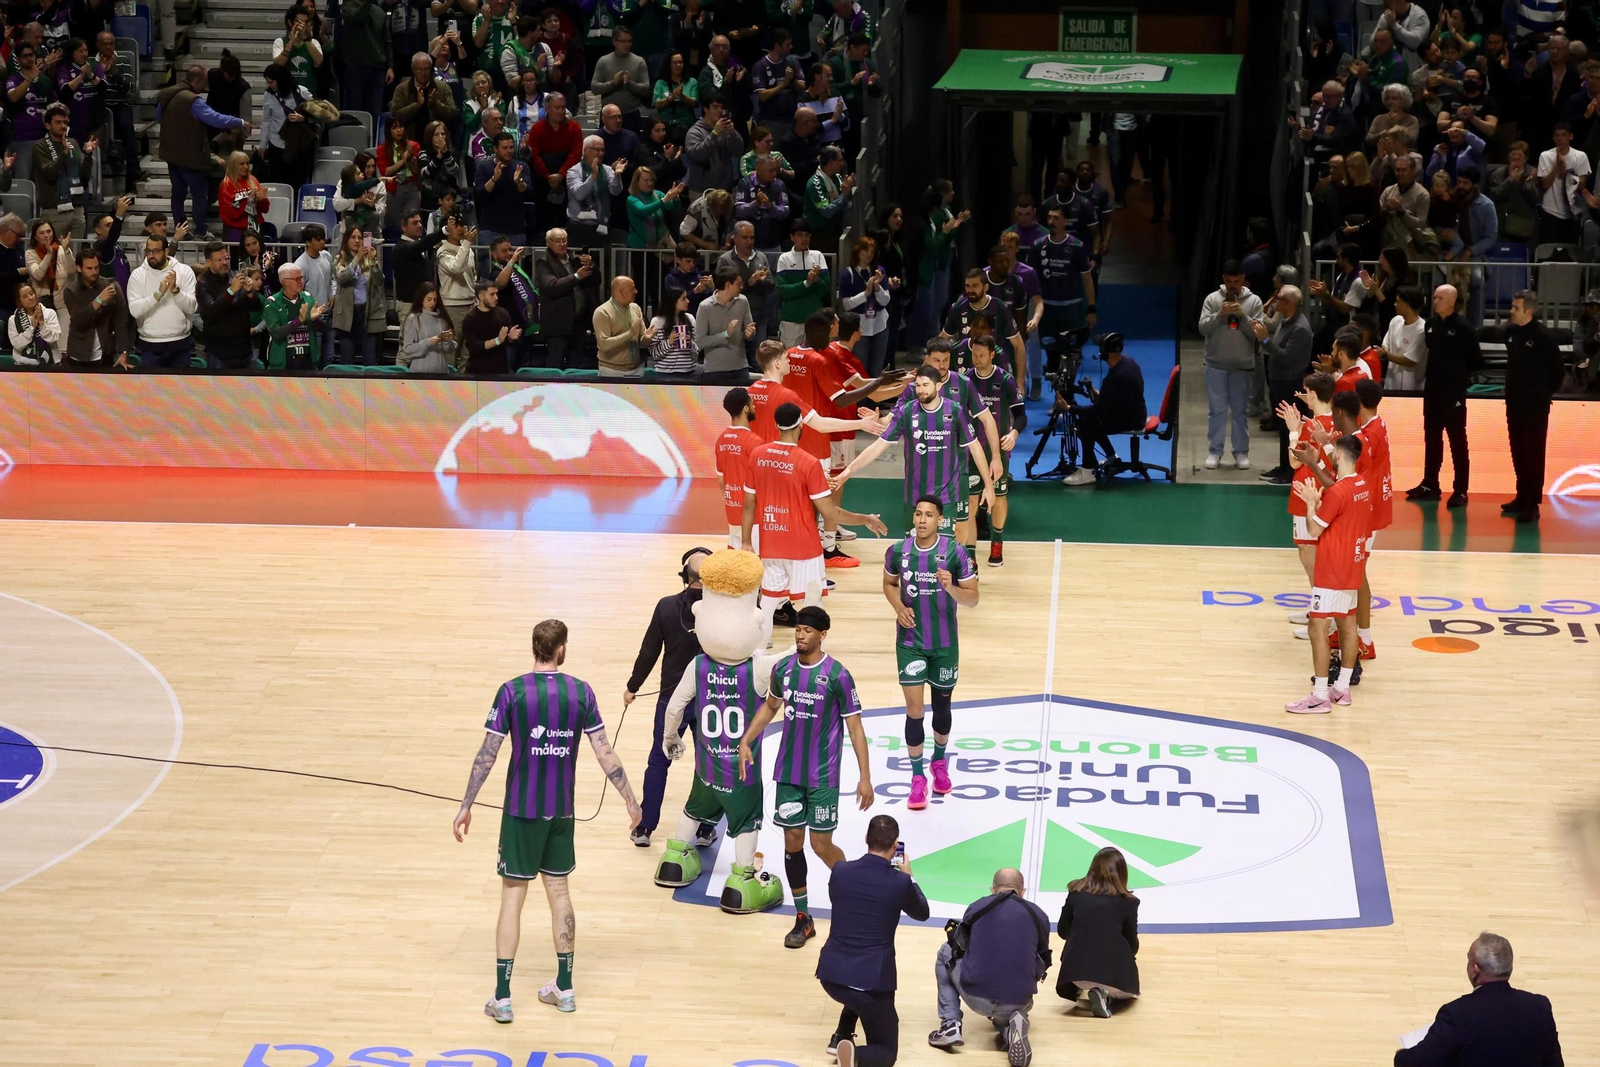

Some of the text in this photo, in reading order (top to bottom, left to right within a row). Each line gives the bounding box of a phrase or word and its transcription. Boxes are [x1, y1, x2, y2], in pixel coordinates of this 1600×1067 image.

[1069, 19, 1128, 34] SALIDA DE
[1064, 36, 1131, 51] EMERGENCIA
[757, 457, 795, 471] inmoovs
[763, 523, 790, 532] LOBAL
[1202, 590, 1600, 616] endsa
[1428, 616, 1600, 644] iga
[707, 672, 738, 686] Chicui
[701, 704, 745, 739] 00
[546, 729, 574, 739] Unicaja
